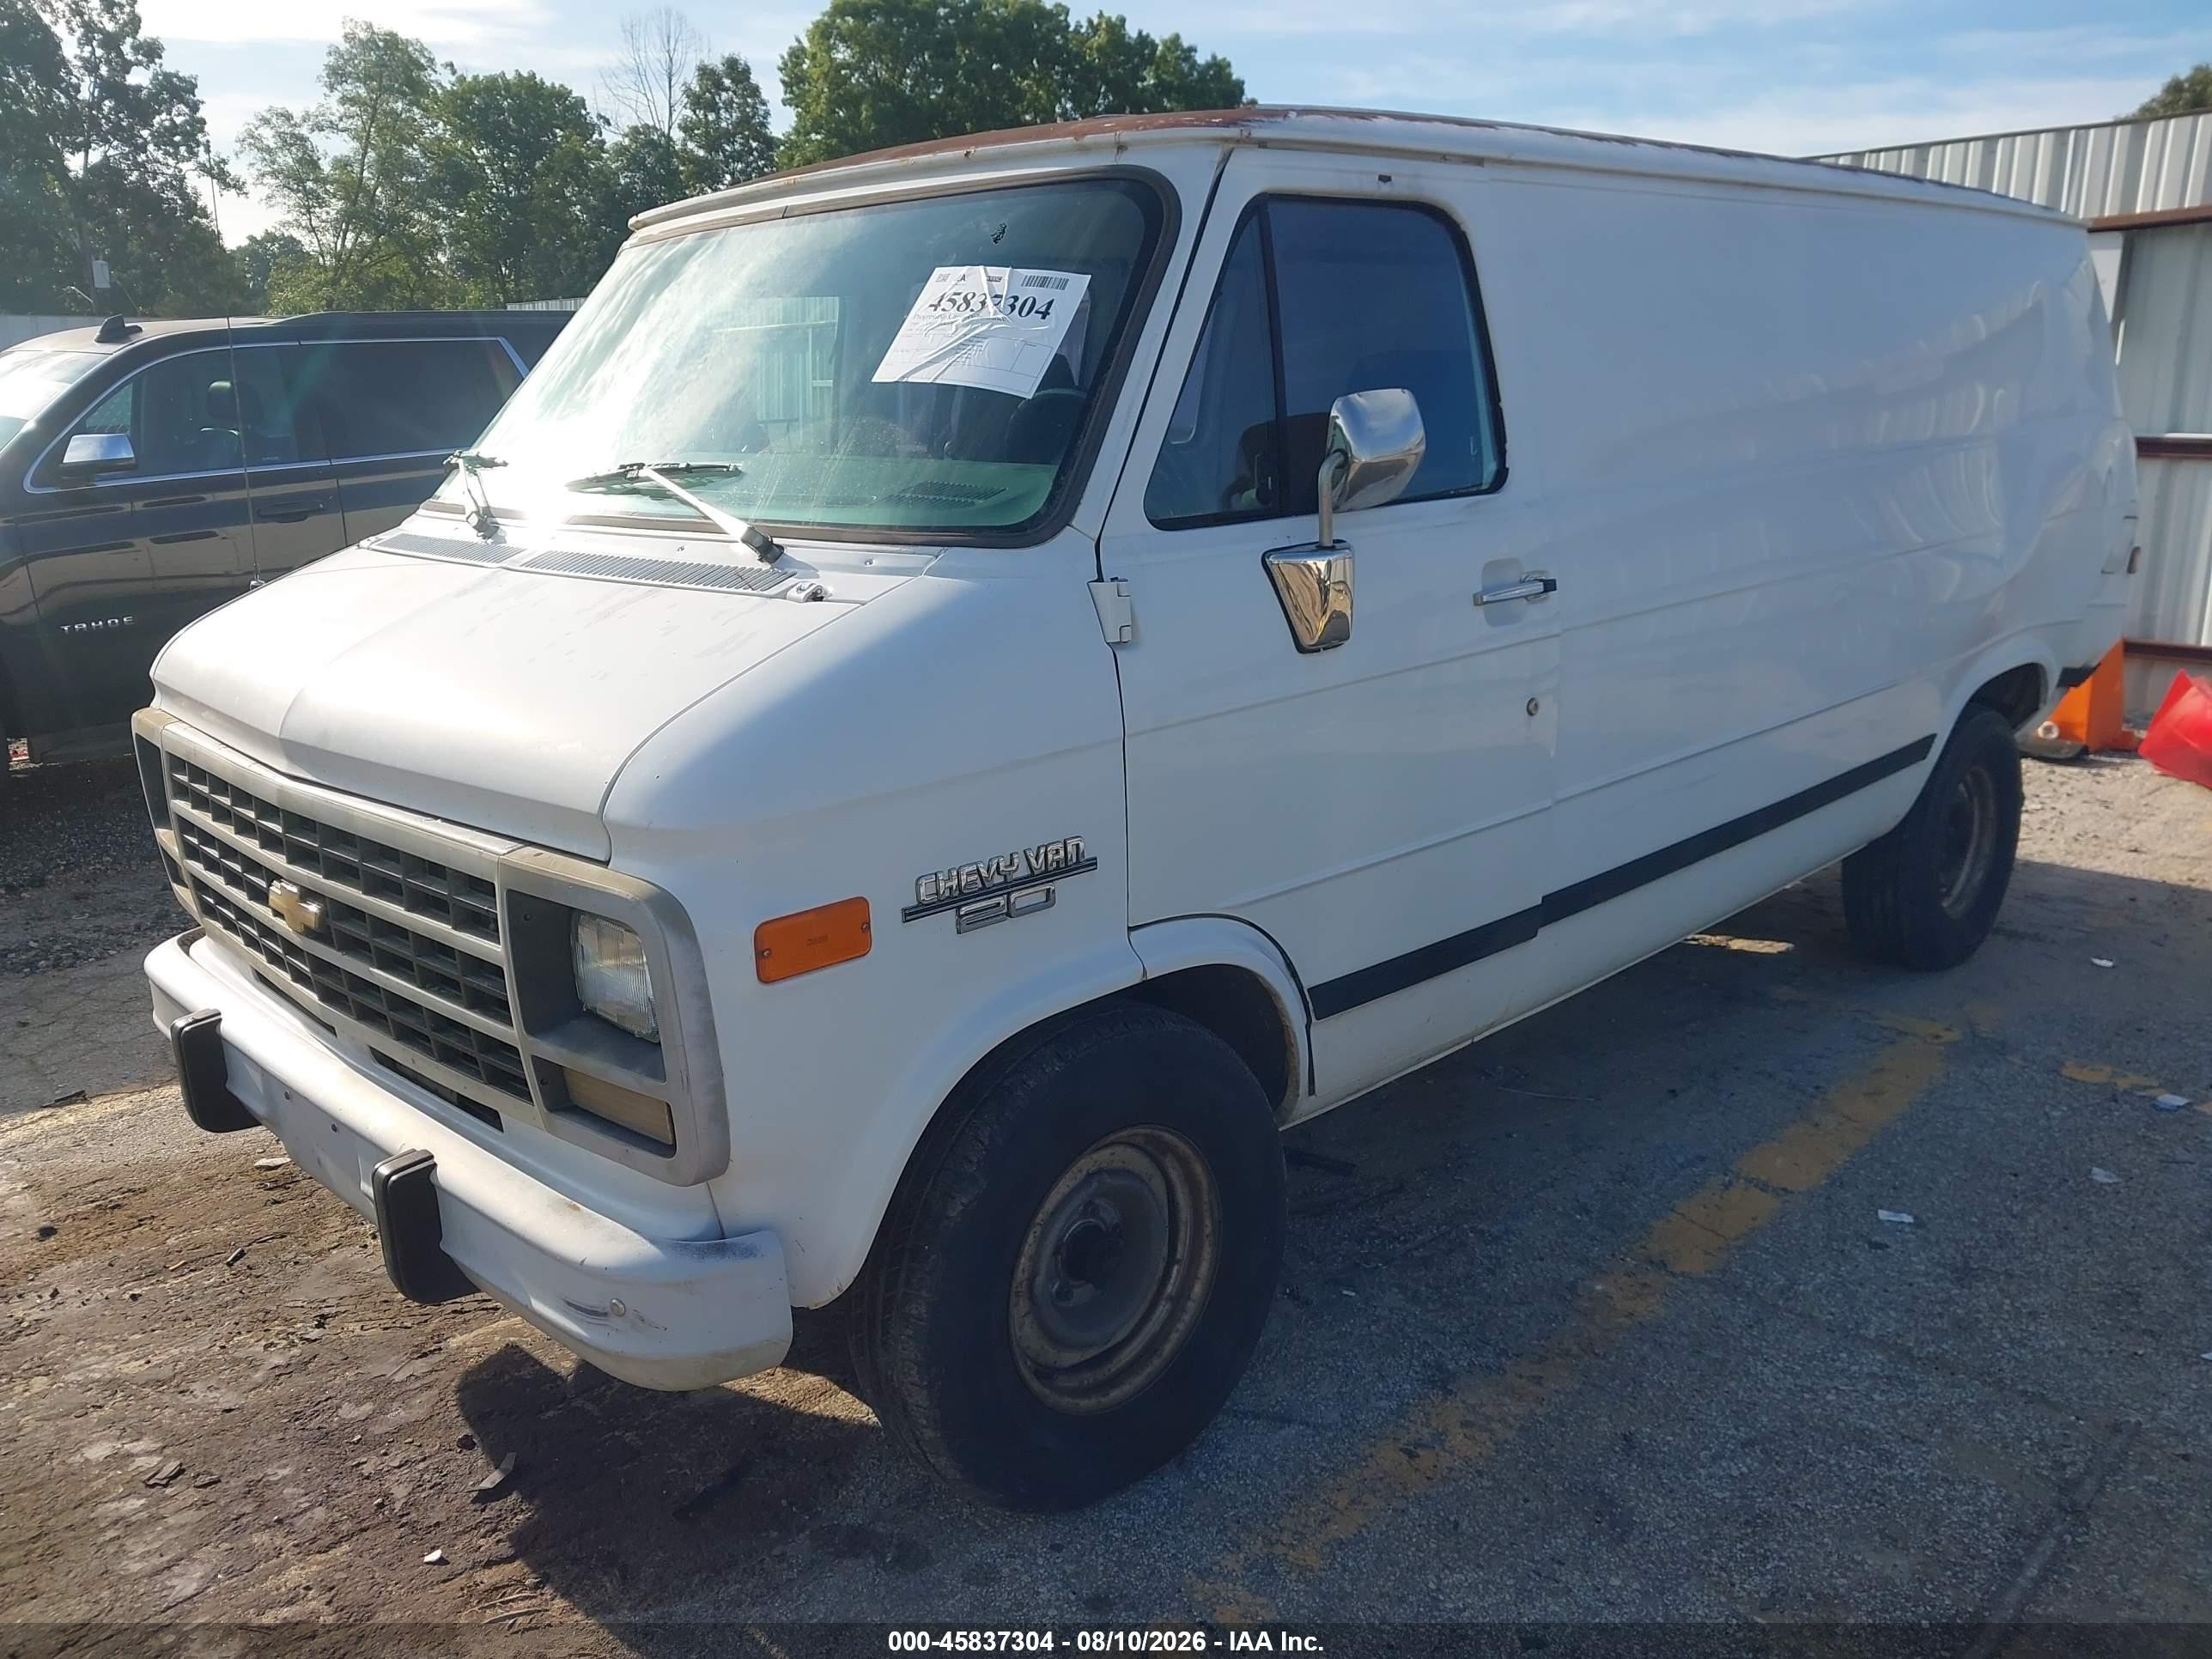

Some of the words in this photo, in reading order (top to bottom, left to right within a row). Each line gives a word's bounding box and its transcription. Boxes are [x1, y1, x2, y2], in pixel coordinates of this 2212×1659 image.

[59, 616, 134, 634] TAHOE
[915, 851, 1019, 903] CHEVY
[957, 882, 1056, 934] 20
